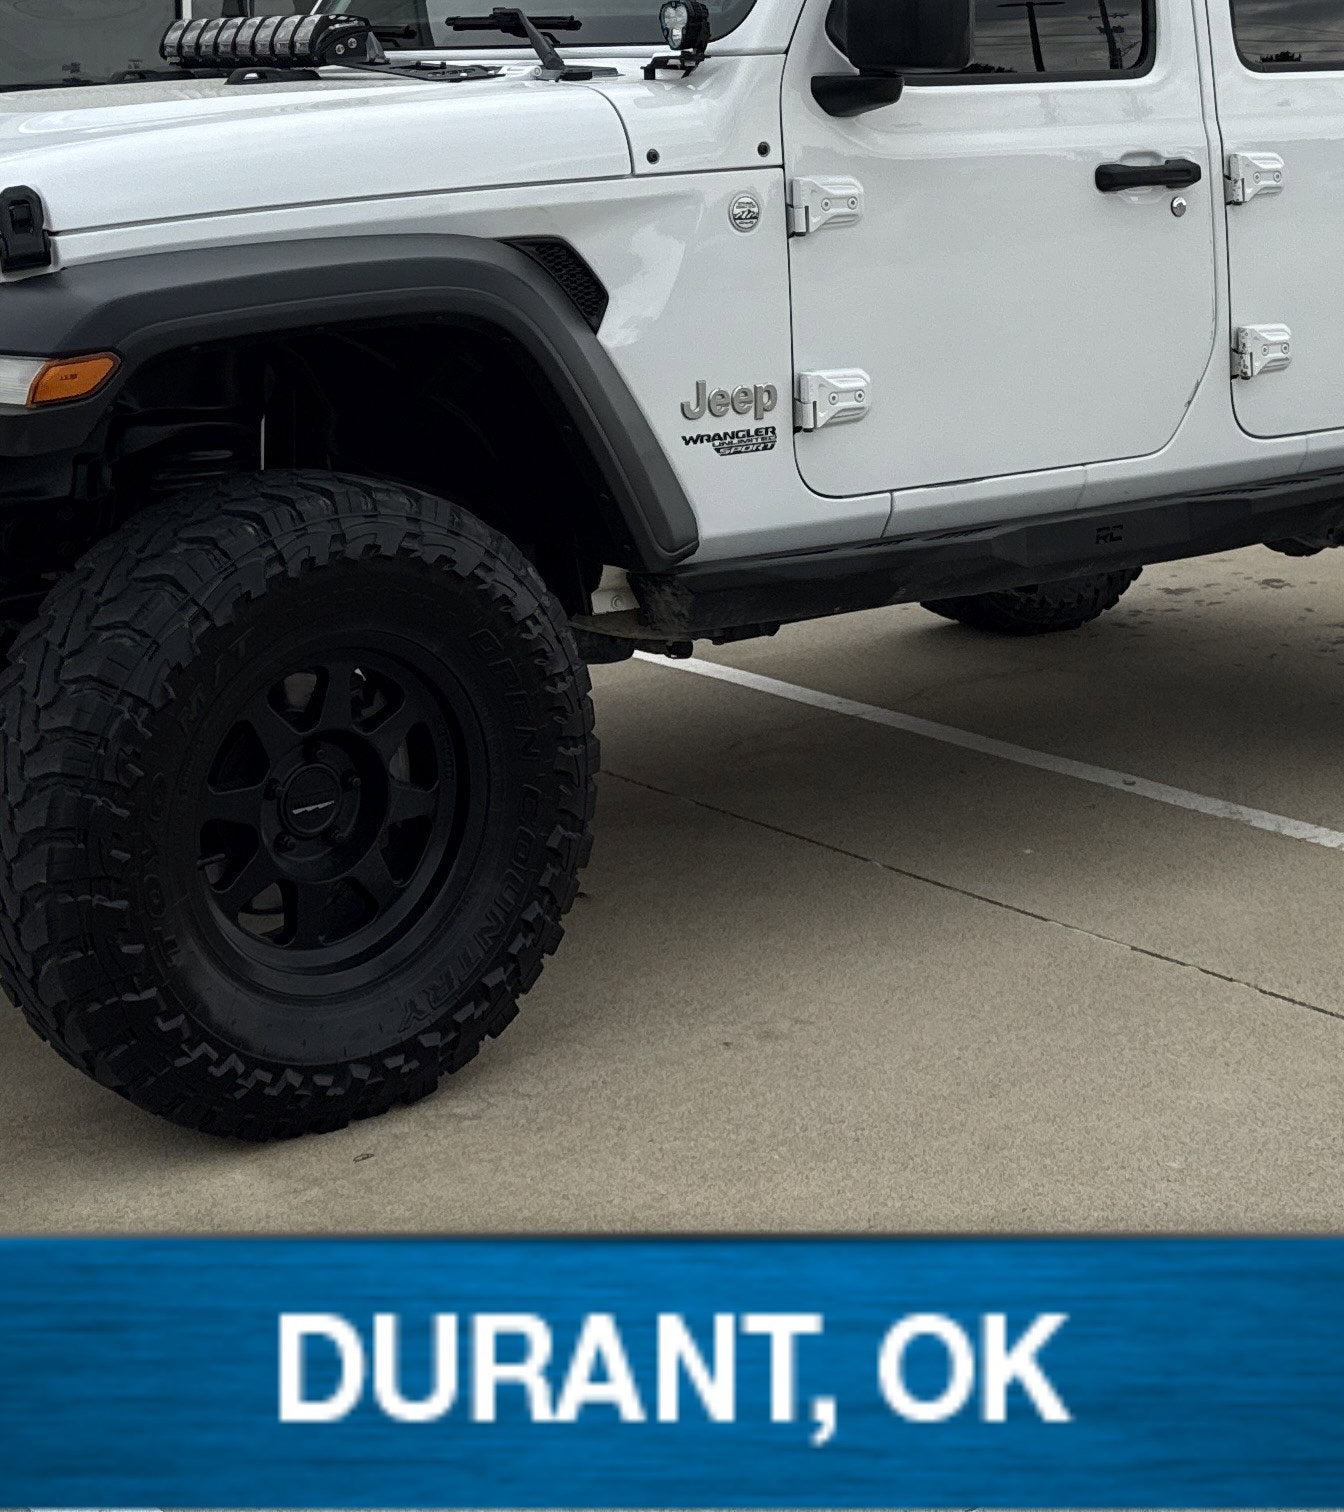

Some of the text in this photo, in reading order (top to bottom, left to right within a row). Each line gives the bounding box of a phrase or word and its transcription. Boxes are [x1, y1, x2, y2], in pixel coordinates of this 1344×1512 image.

[680, 379, 778, 421] Jeep
[681, 425, 777, 446] WRANGLER
[712, 435, 777, 448] UNLIMITED
[718, 442, 774, 455] SPORT
